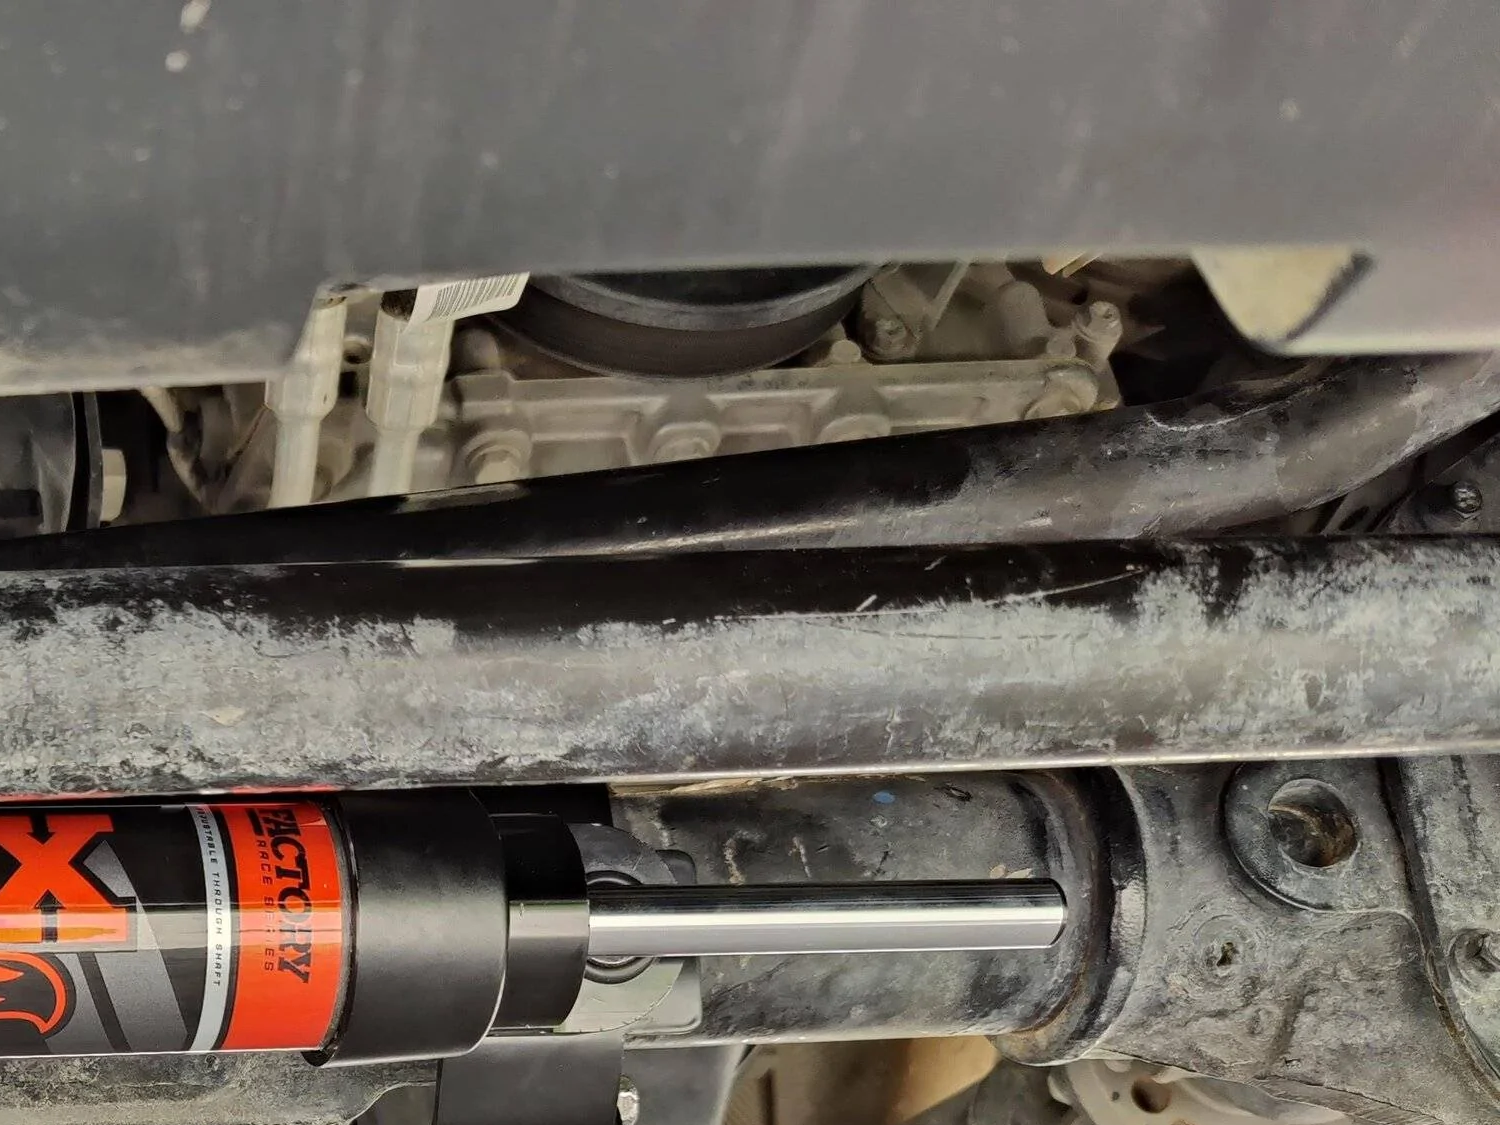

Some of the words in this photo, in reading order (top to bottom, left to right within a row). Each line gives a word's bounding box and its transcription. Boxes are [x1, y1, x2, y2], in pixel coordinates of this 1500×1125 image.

[257, 840, 274, 886] RACE
[211, 871, 223, 936] THROUGH
[258, 808, 312, 984] FACTORY
[213, 943, 223, 988] SHAFT
